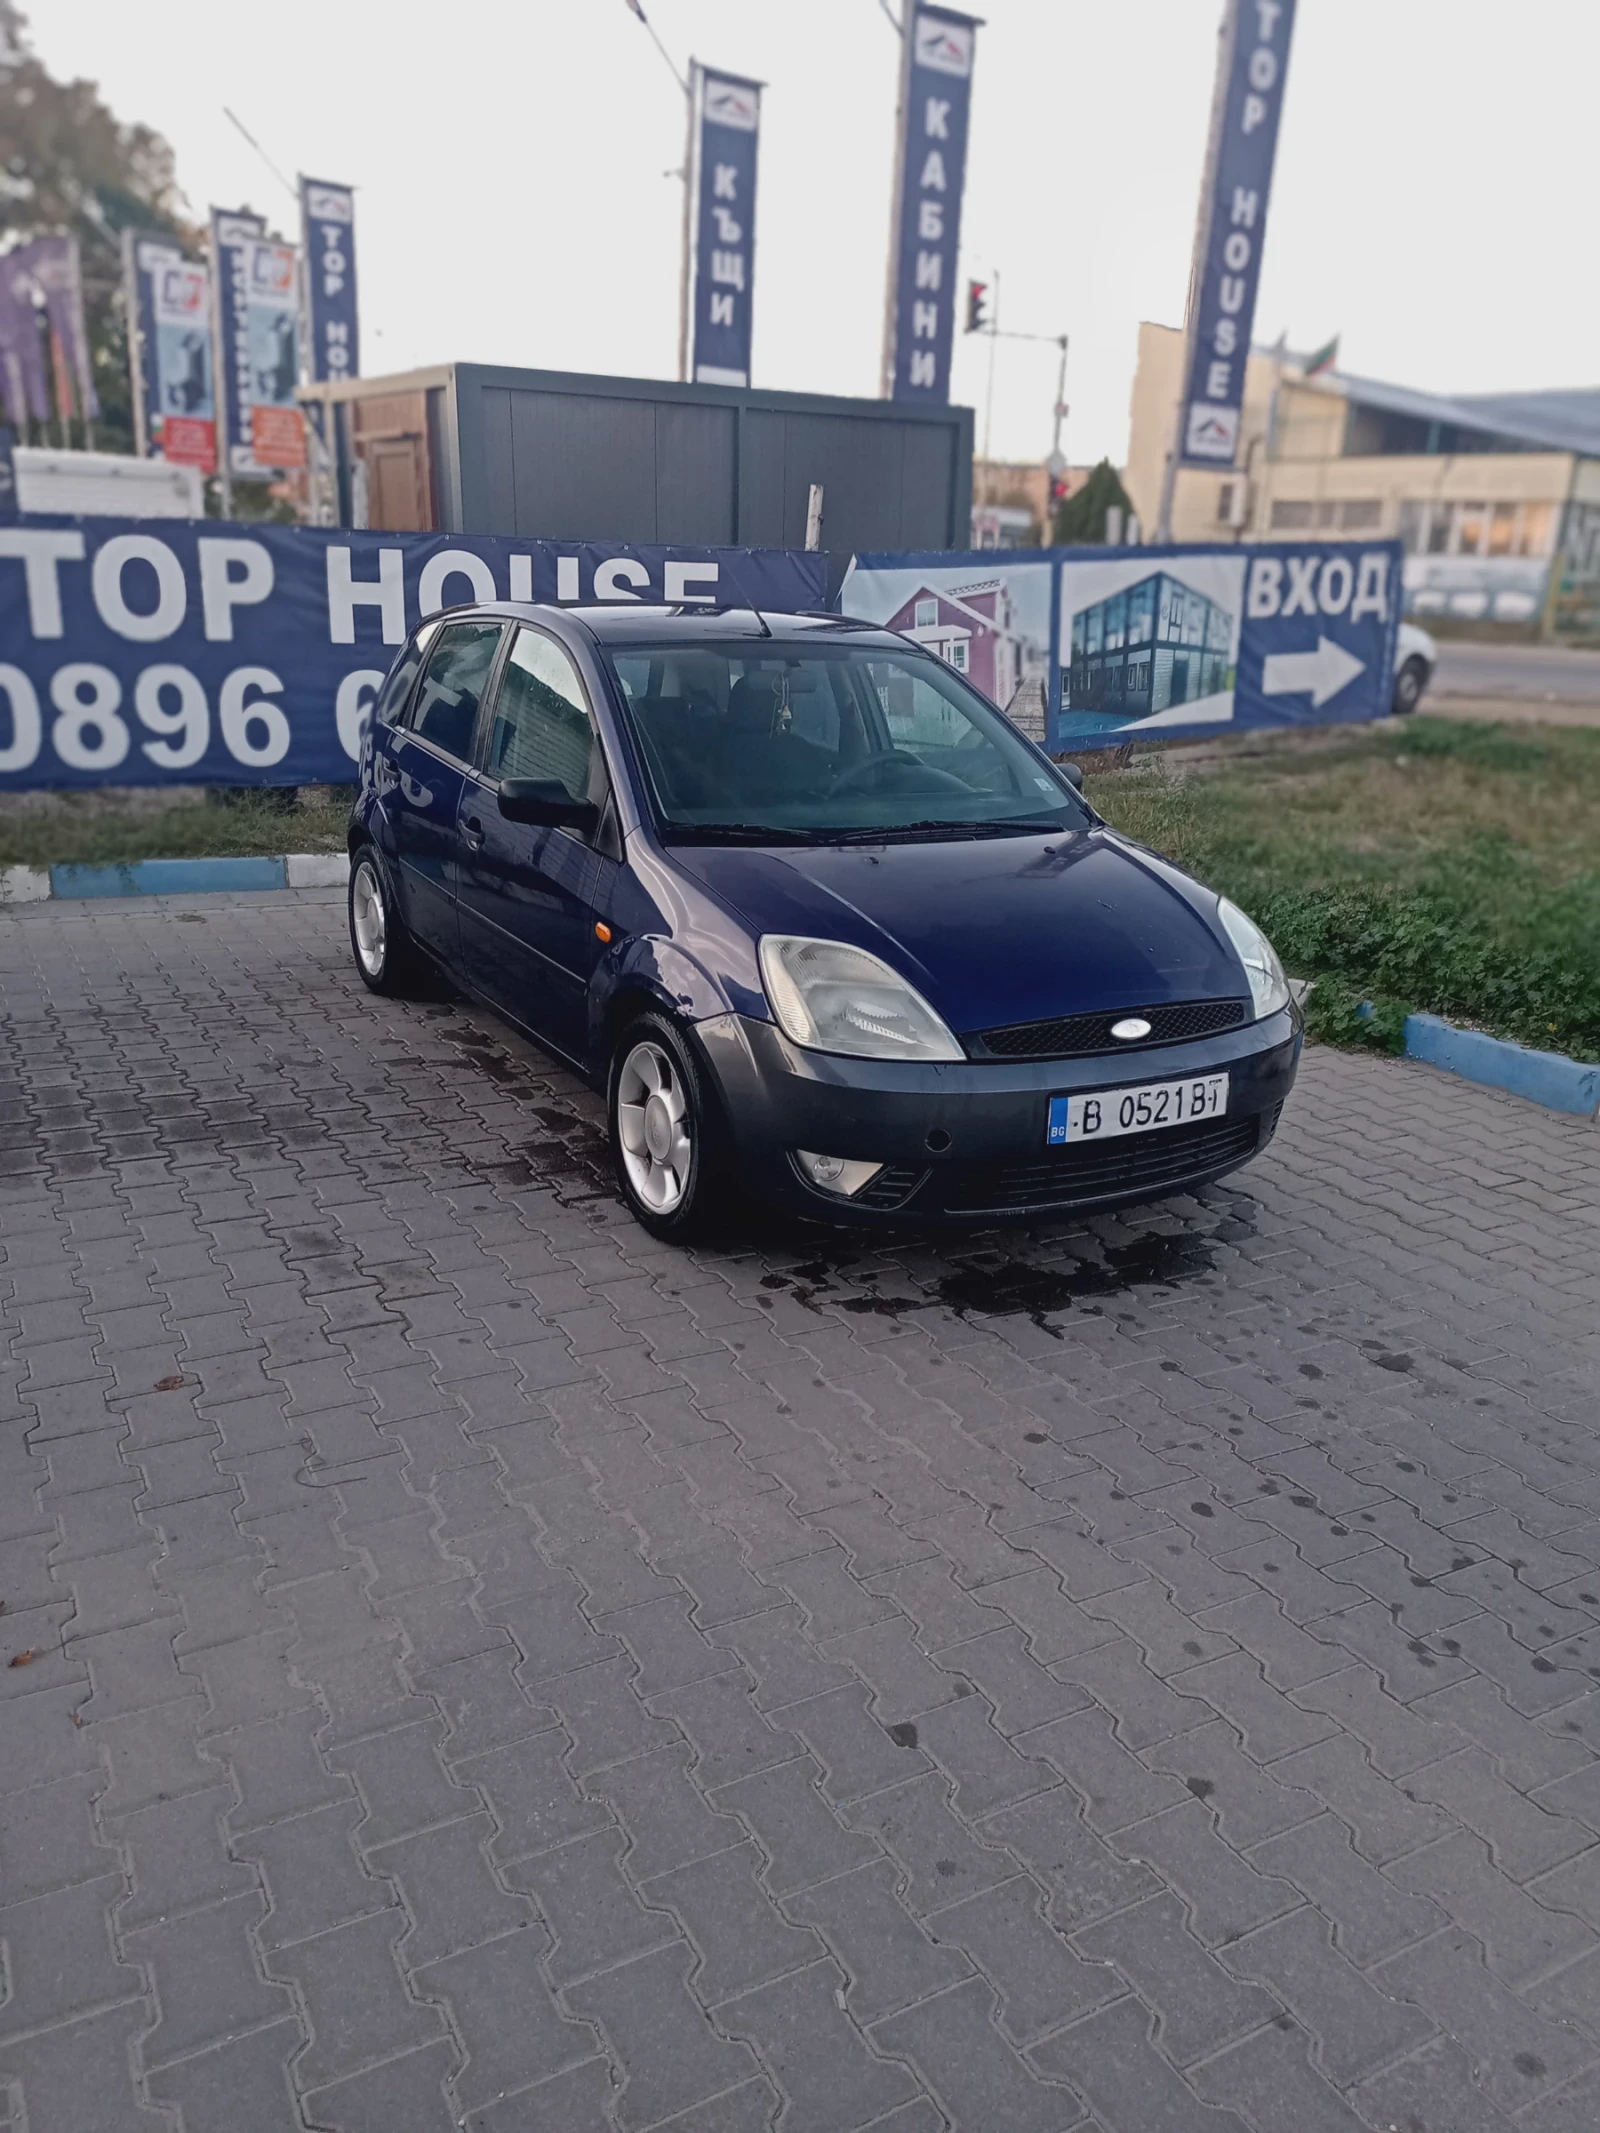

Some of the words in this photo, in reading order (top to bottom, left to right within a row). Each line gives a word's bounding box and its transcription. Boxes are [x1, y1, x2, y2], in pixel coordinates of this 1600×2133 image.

[1241, 0, 1282, 135] TOP
[320, 223, 347, 298] TOP
[710, 161, 745, 327] КЪЩИ
[909, 96, 950, 389] КАБИНИ
[1206, 186, 1259, 400] HOUSE
[0, 528, 275, 642] TOP
[1248, 553, 1389, 623] ВХОД
[1051, 1126, 1065, 1138] BG
[1119, 1086, 1183, 1128] 0521
